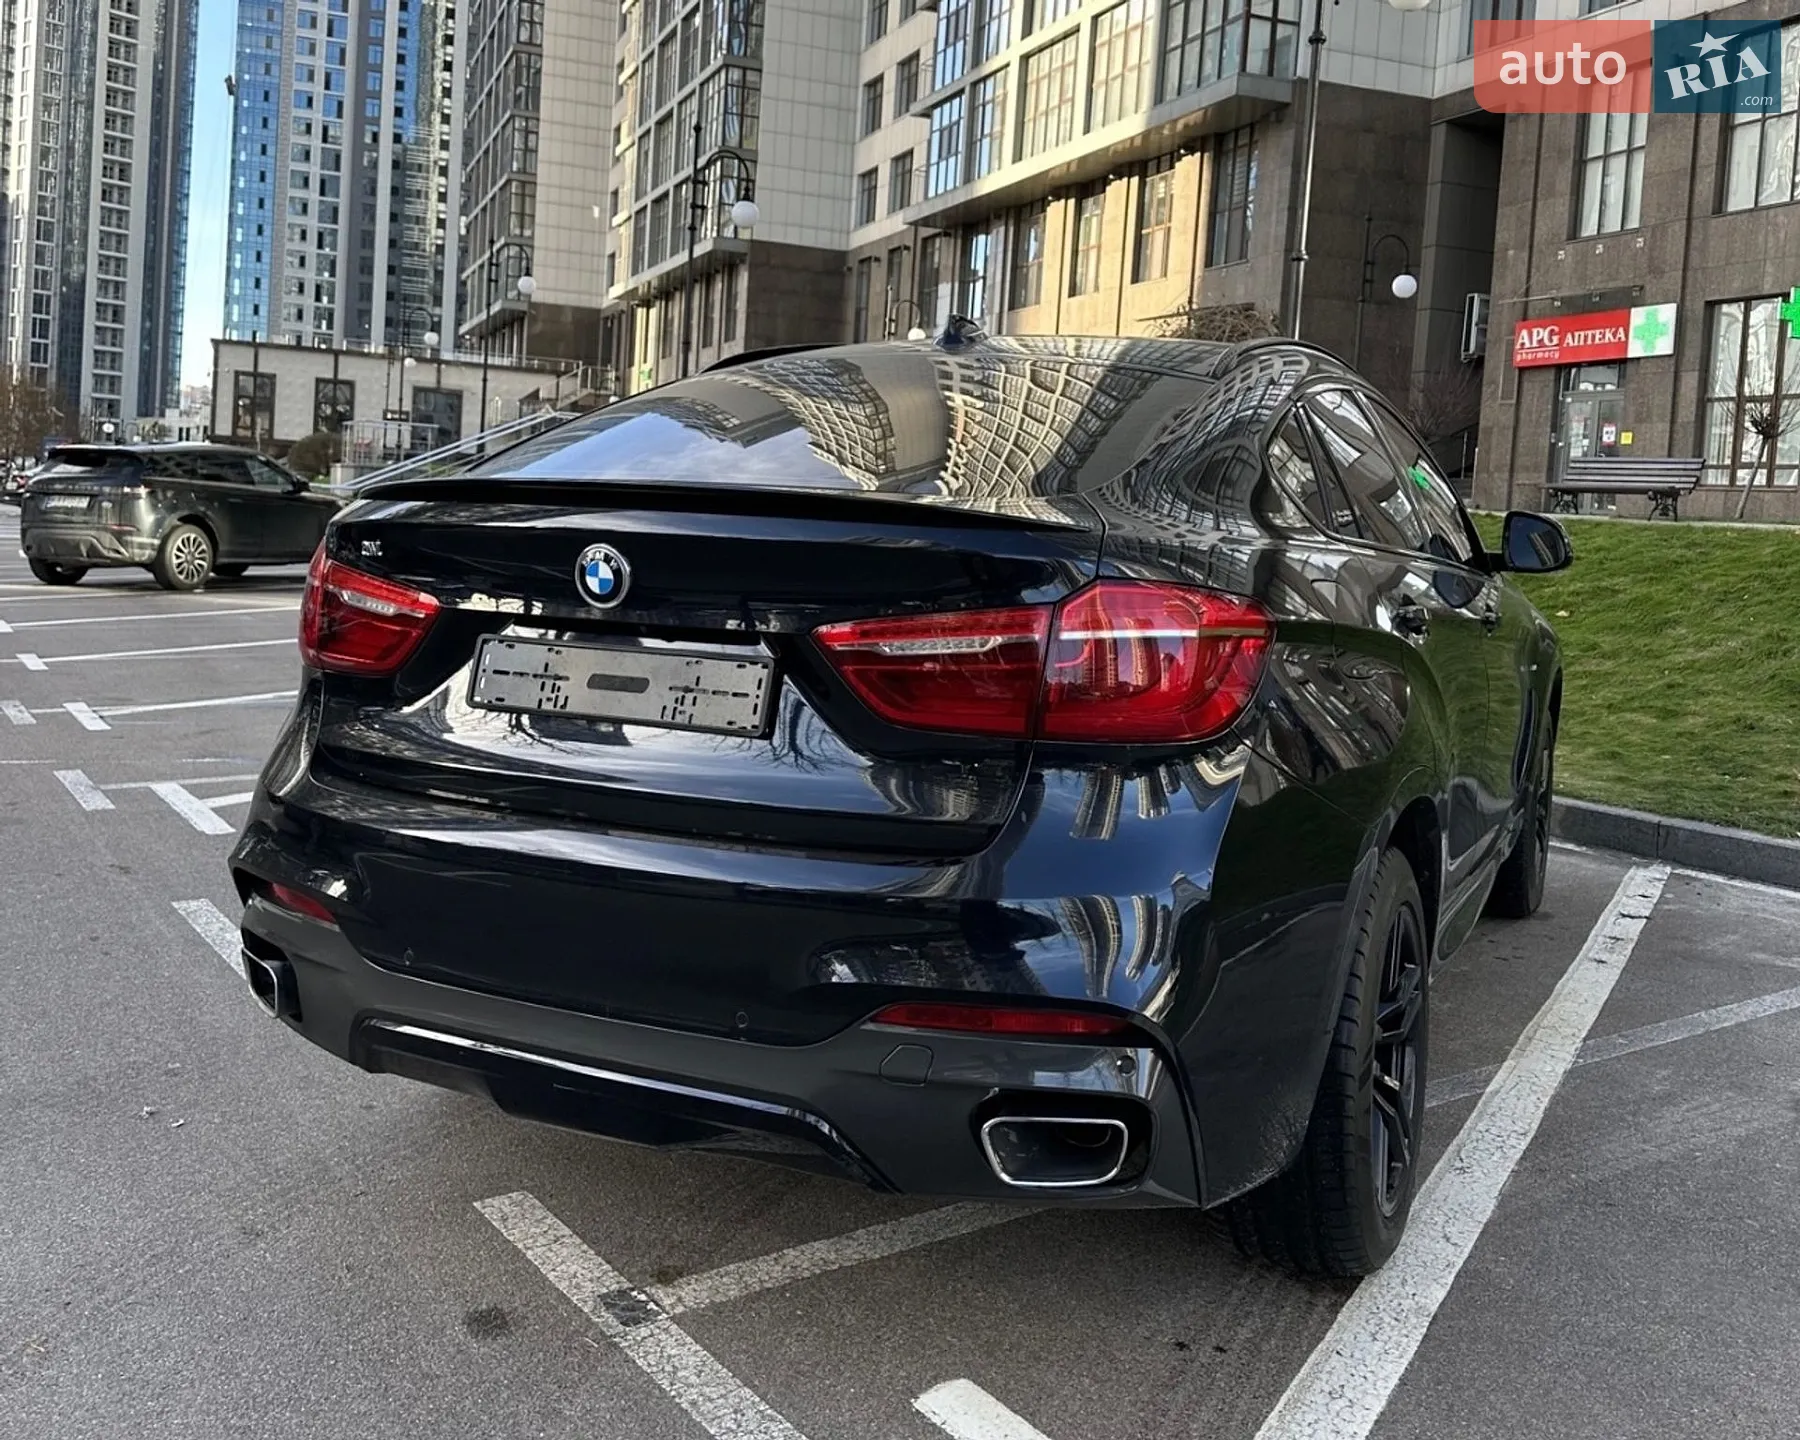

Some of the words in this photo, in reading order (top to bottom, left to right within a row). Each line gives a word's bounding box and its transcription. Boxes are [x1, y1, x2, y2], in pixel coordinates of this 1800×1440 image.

[1515, 325, 1560, 349] APG
[1563, 326, 1627, 347] АПТЕКА
[1516, 350, 1560, 362] pharmacy
[581, 550, 619, 570] BMW
